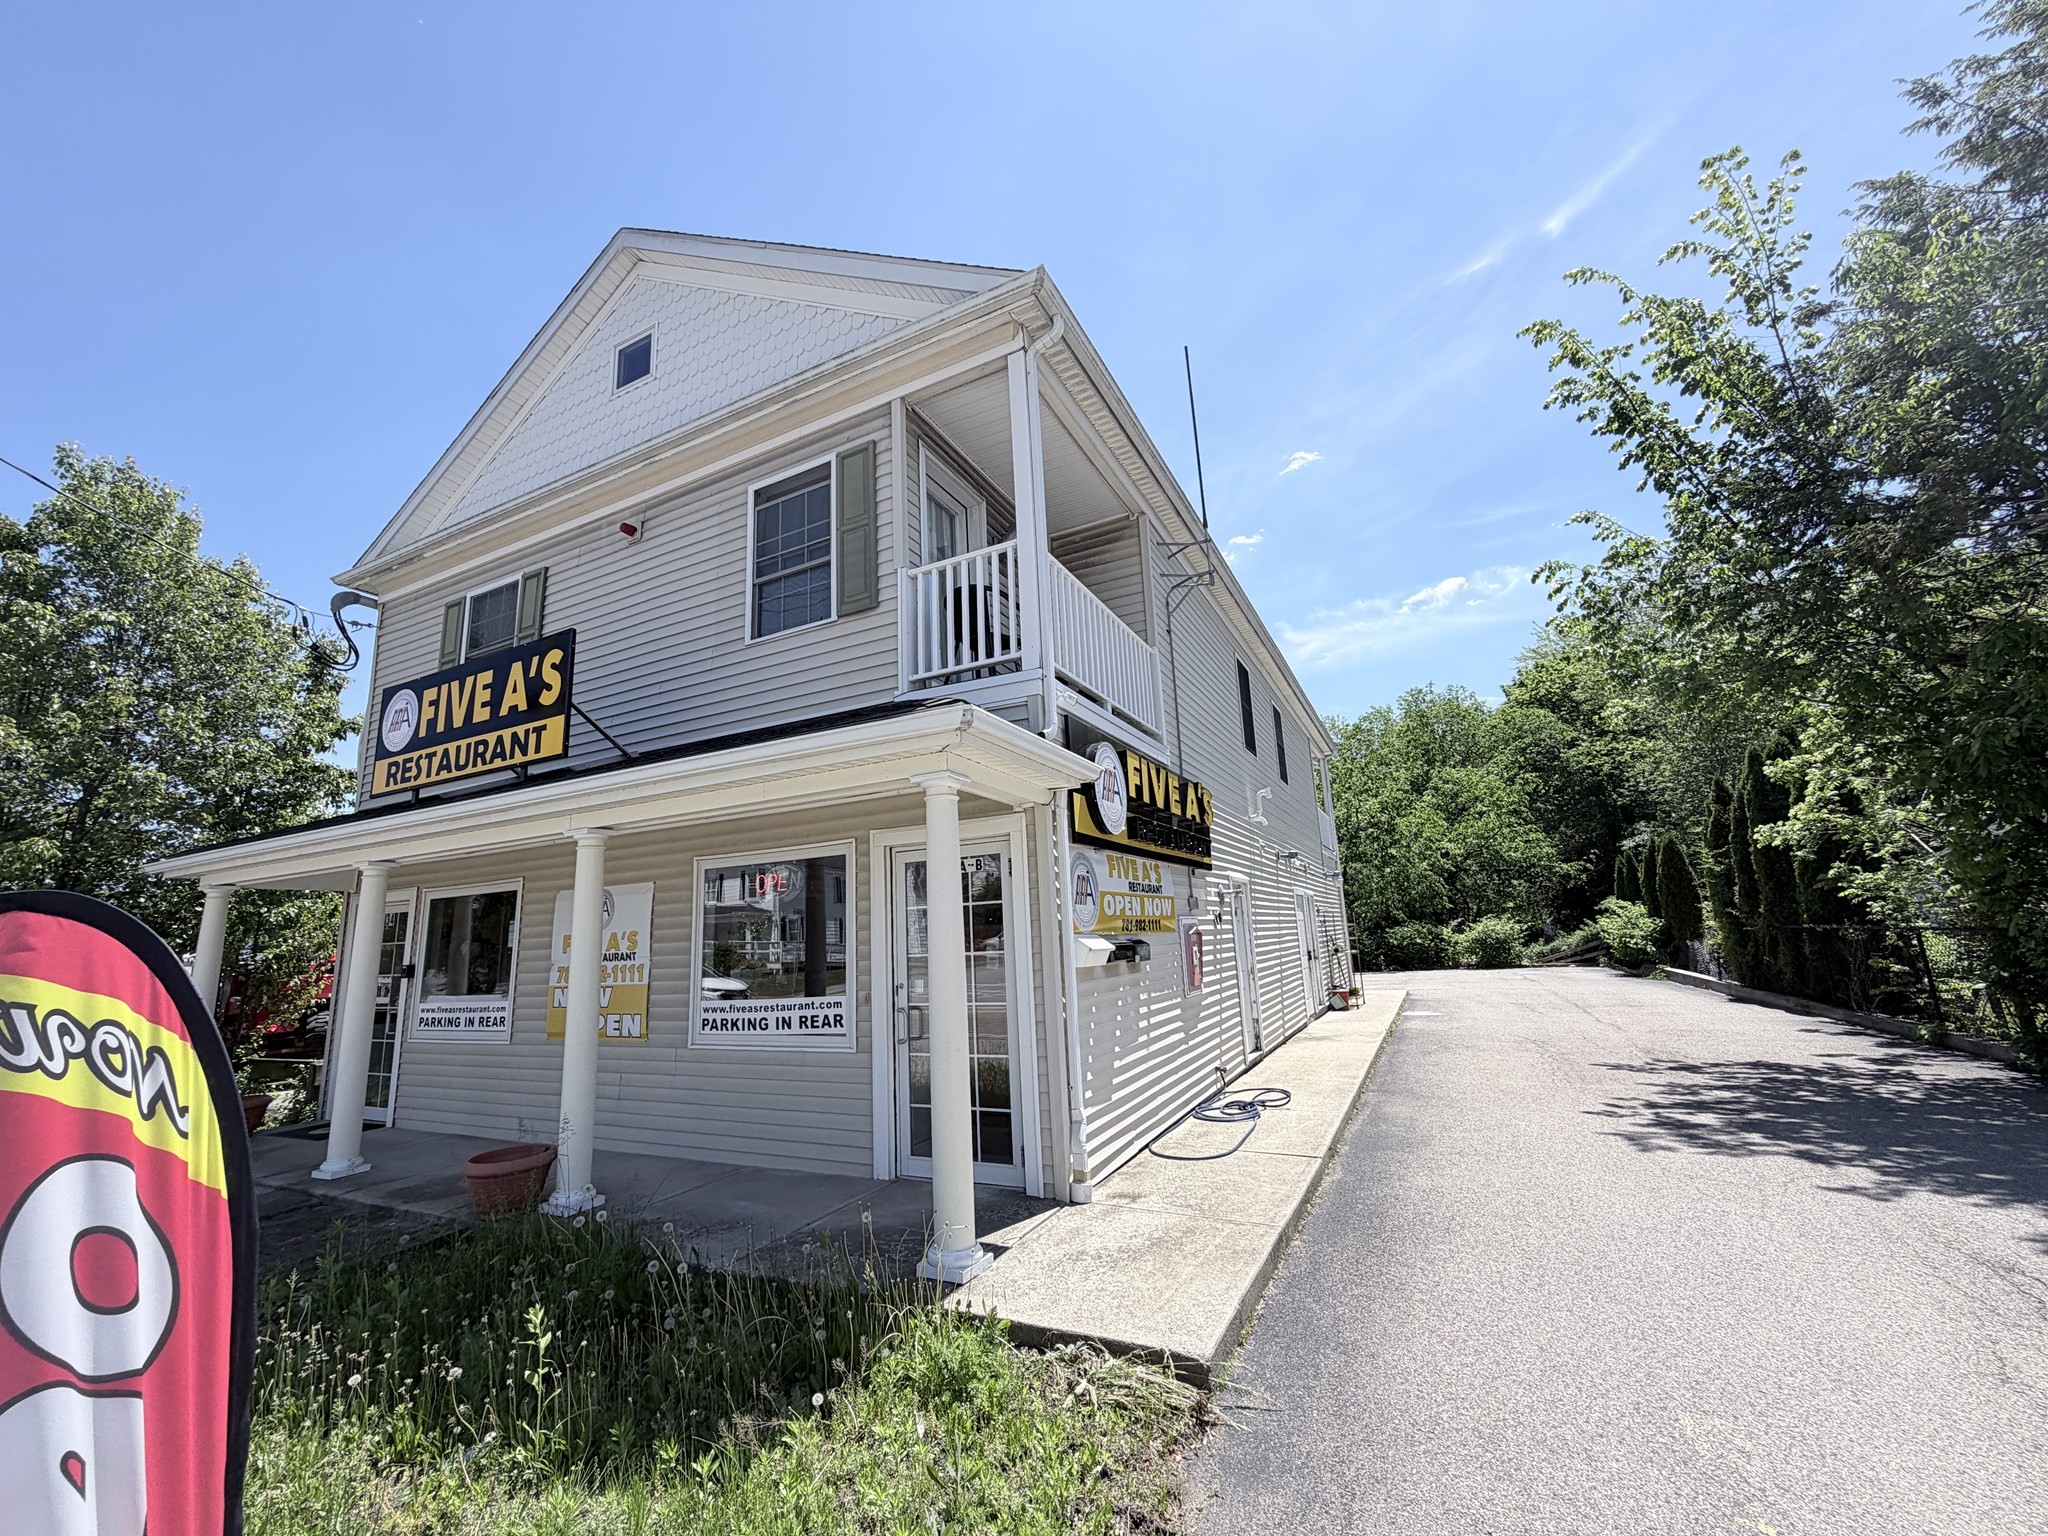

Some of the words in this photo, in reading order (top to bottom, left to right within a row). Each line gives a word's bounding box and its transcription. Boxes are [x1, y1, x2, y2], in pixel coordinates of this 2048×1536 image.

[418, 669, 494, 738] FIVE
[499, 648, 564, 717] A'S
[385, 723, 547, 787] RESTAURANT
[1127, 750, 1182, 816] FIVE
[1186, 782, 1214, 827] A'S
[1106, 853, 1139, 881] FIVE
[1142, 861, 1162, 884] A'S
[1128, 881, 1163, 895] RESTAURANT
[1103, 894, 1141, 916] OPEN
[1144, 897, 1172, 917] NOW
[1121, 918, 1162, 932] 781-982-1111
[605, 930, 639, 952] A'S
[601, 952, 637, 962] AURANT
[557, 963, 644, 984] 782-1111
[553, 986, 613, 1008] NW
[702, 1000, 843, 1014] www.fiveasrestaurant.com
[420, 1005, 506, 1014] www.fiveasrestaurant.com
[418, 1016, 461, 1028] PARKING
[464, 1016, 475, 1028] IN
[478, 1016, 506, 1028] REAR
[701, 1017, 769, 1032] PARKING
[775, 1016, 792, 1030] IN
[799, 1014, 845, 1030] REAR
